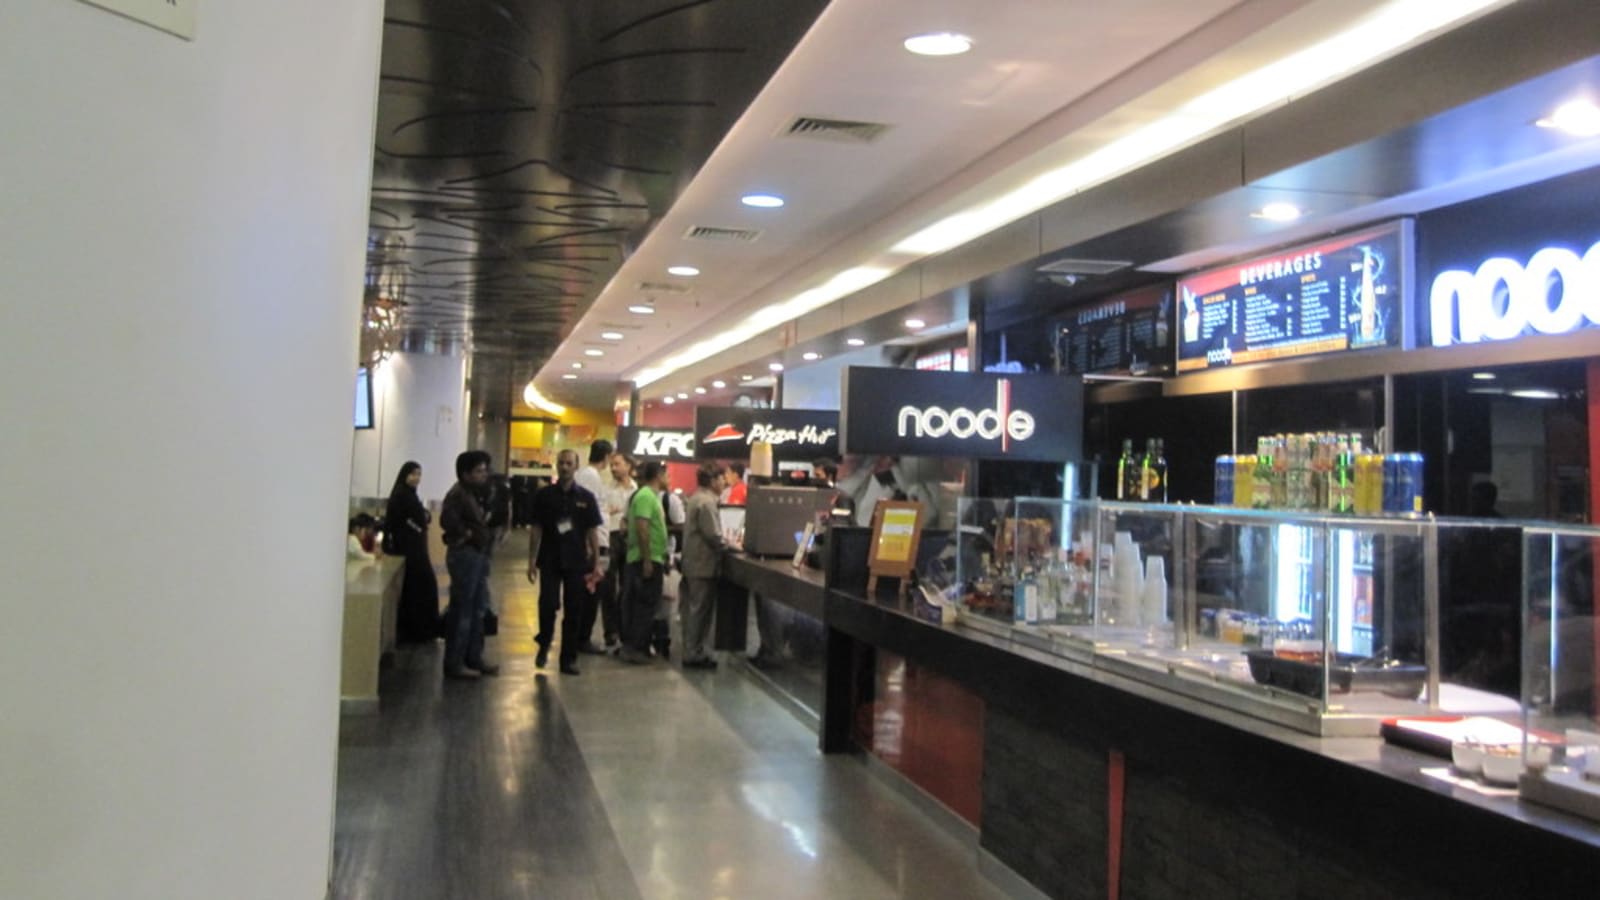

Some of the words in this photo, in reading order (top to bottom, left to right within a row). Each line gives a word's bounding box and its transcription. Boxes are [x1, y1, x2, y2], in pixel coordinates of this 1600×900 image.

[1240, 252, 1323, 286] BEVERAGES
[898, 378, 1035, 452] noodle
[633, 431, 695, 457] KFC
[746, 423, 796, 445] Pizza
[798, 424, 836, 445] Hut
